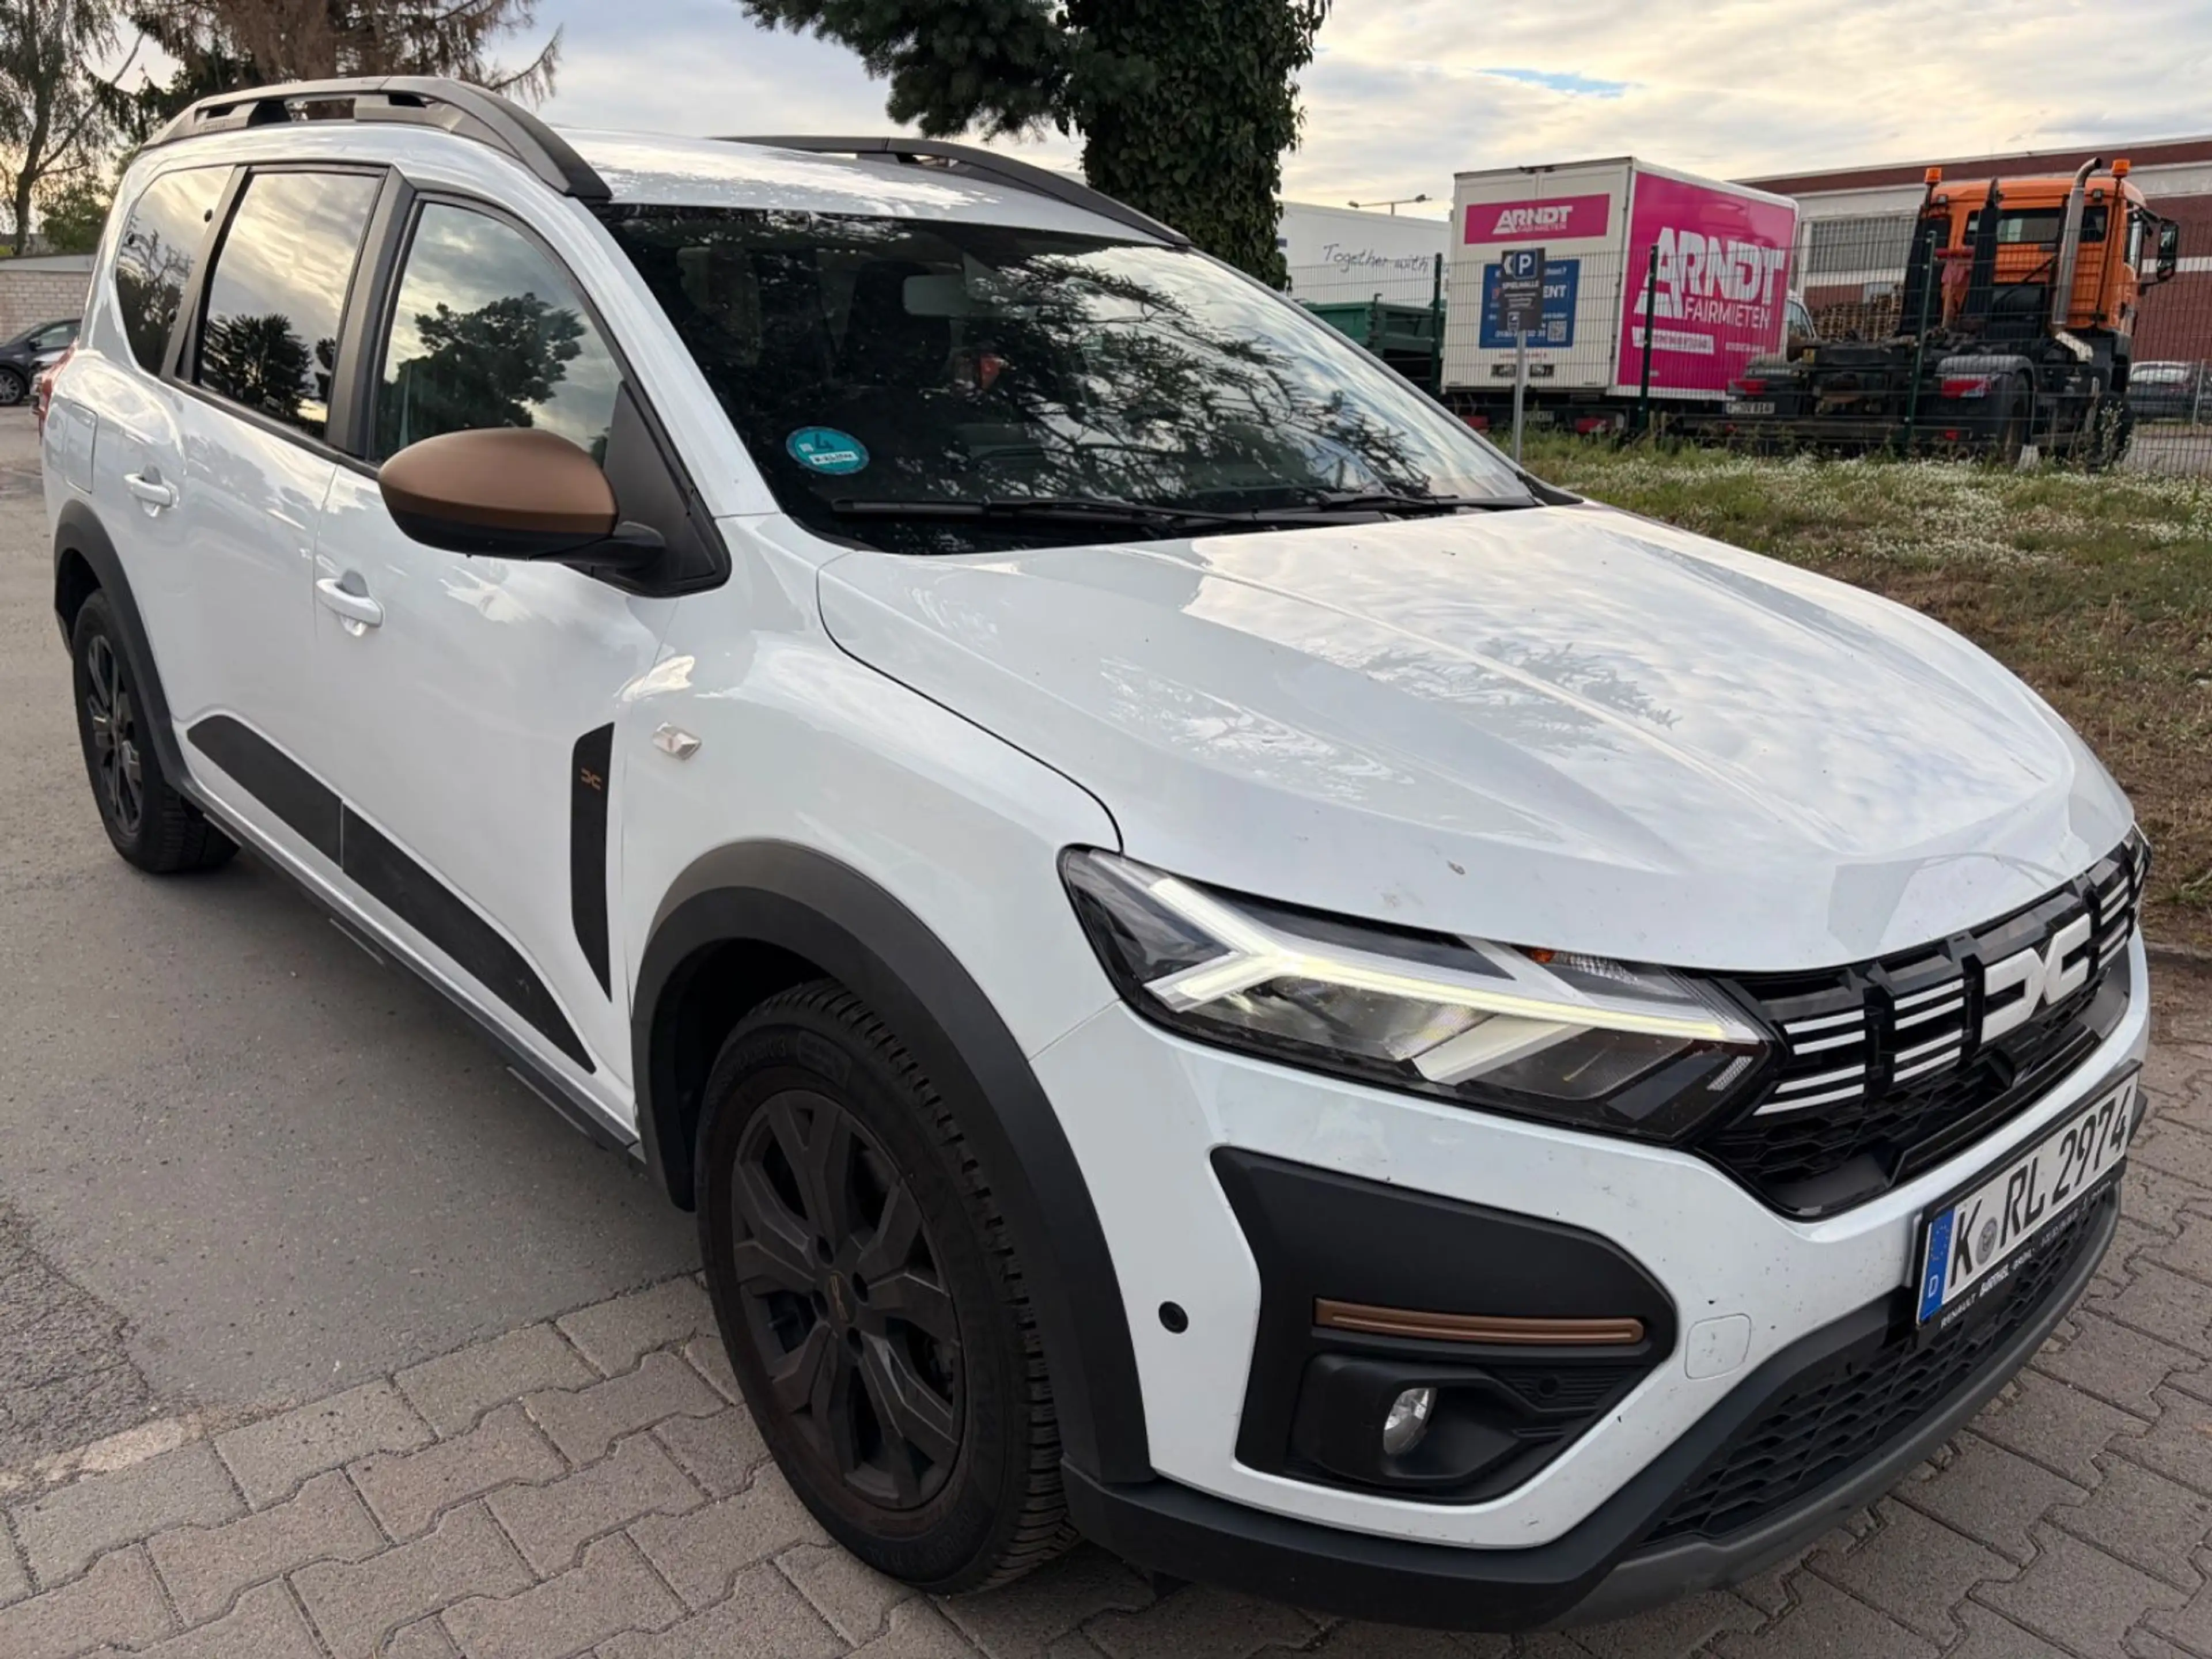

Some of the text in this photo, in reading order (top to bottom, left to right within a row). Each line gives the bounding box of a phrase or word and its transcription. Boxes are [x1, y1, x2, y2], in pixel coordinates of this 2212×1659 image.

[1493, 205, 1573, 235] ARNDT
[1323, 243, 1388, 274] Together
[1518, 253, 1532, 275] P
[1634, 226, 1786, 319] ARNDT
[1682, 297, 1771, 329] FAIRMIETEN
[1949, 1198, 1983, 1289] K
[2051, 1085, 2131, 1206] 2974
